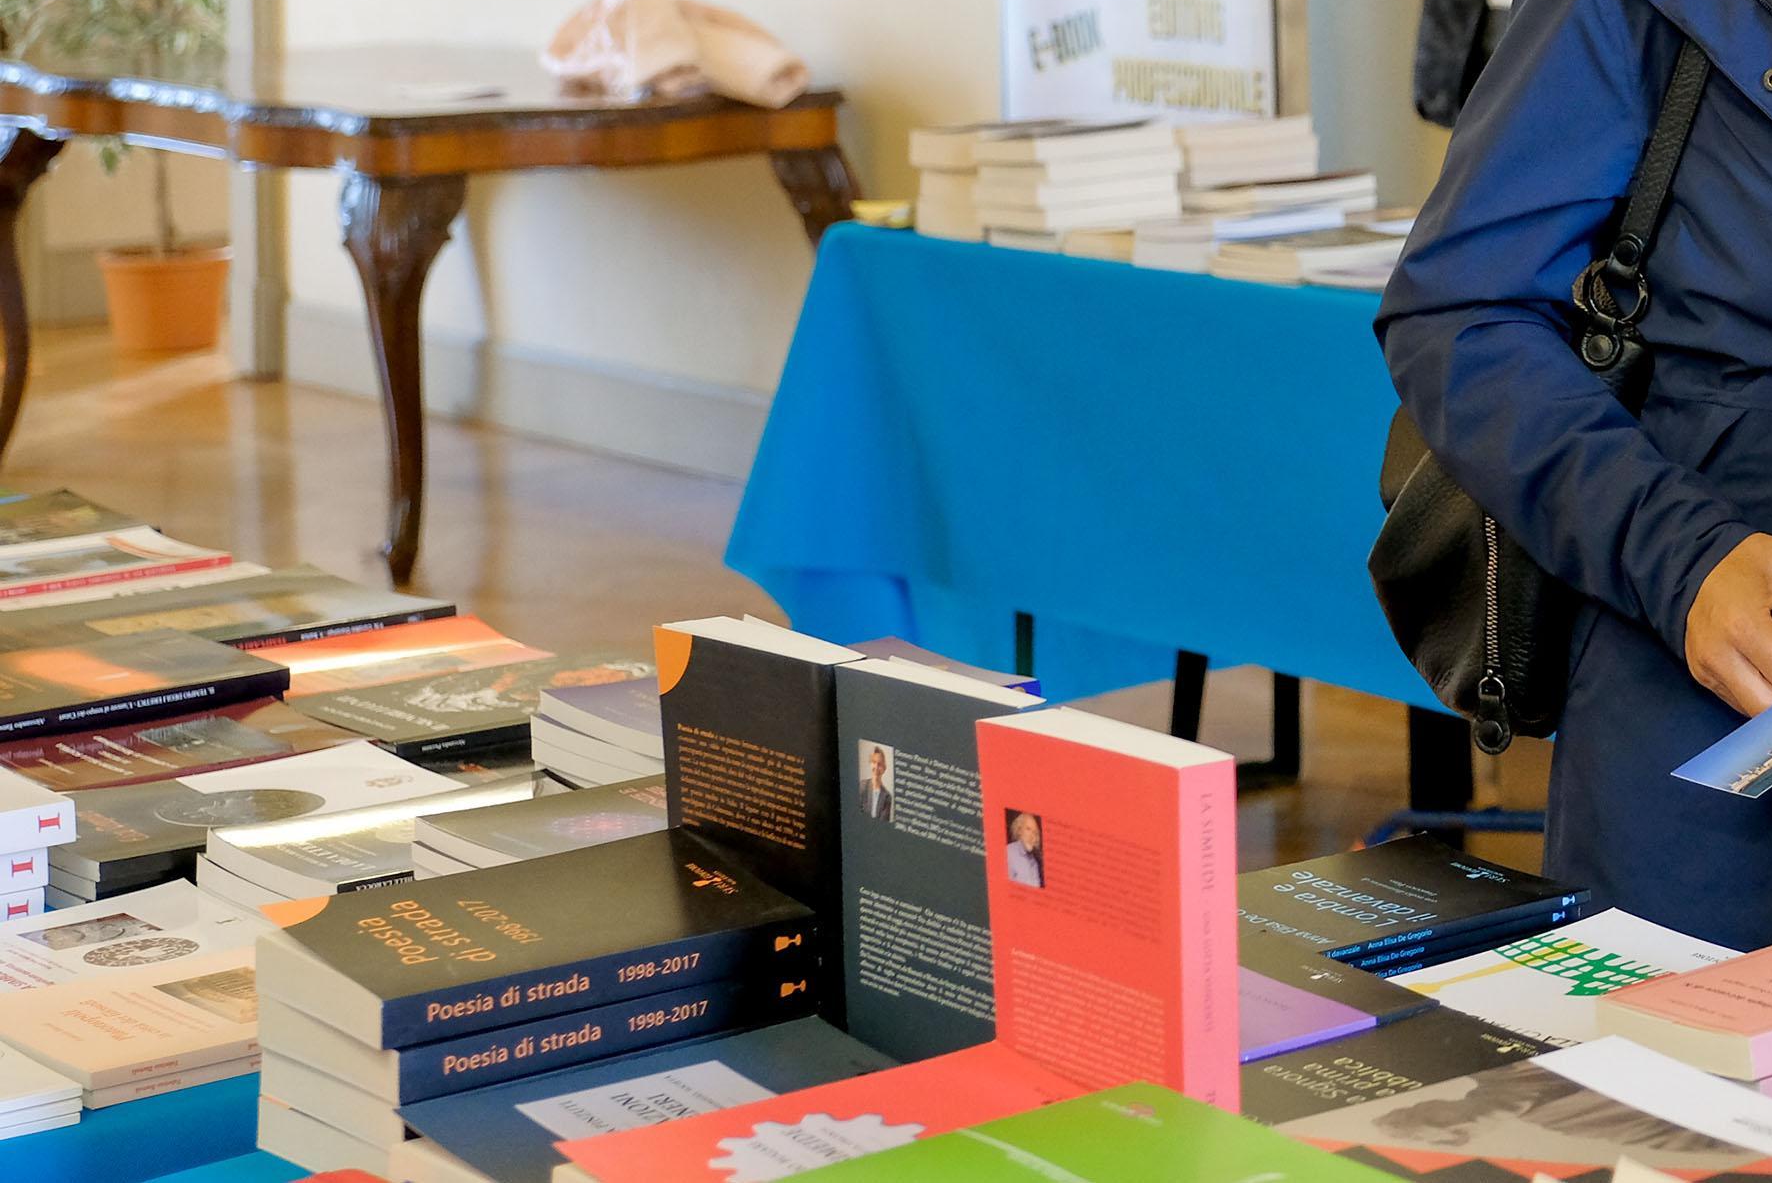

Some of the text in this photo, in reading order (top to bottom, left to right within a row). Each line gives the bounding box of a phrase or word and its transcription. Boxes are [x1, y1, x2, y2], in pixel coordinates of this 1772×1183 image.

[1273, 882, 1400, 928] L'ombra e
[1291, 870, 1416, 916] davanzale
[390, 900, 496, 962] di strada
[457, 900, 543, 944] 1998-2017
[1245, 913, 1336, 947] Anna Elisa De
[1405, 912, 1438, 922] il
[1361, 956, 1377, 967] Anna
[1377, 953, 1391, 964] Elisa
[1391, 950, 1400, 960] De
[1400, 946, 1425, 958] Gregorio
[1367, 938, 1383, 949] Anna
[1384, 934, 1398, 946] Elisa
[1398, 933, 1407, 943] De
[1407, 929, 1433, 941] Gregorio
[427, 952, 699, 1023] Poesia di strada 1998-2017
[443, 1000, 708, 1076] Poesia di strada 1998-2017
[1263, 1064, 1349, 1100] signora
[1303, 1062, 1381, 1090] prima
